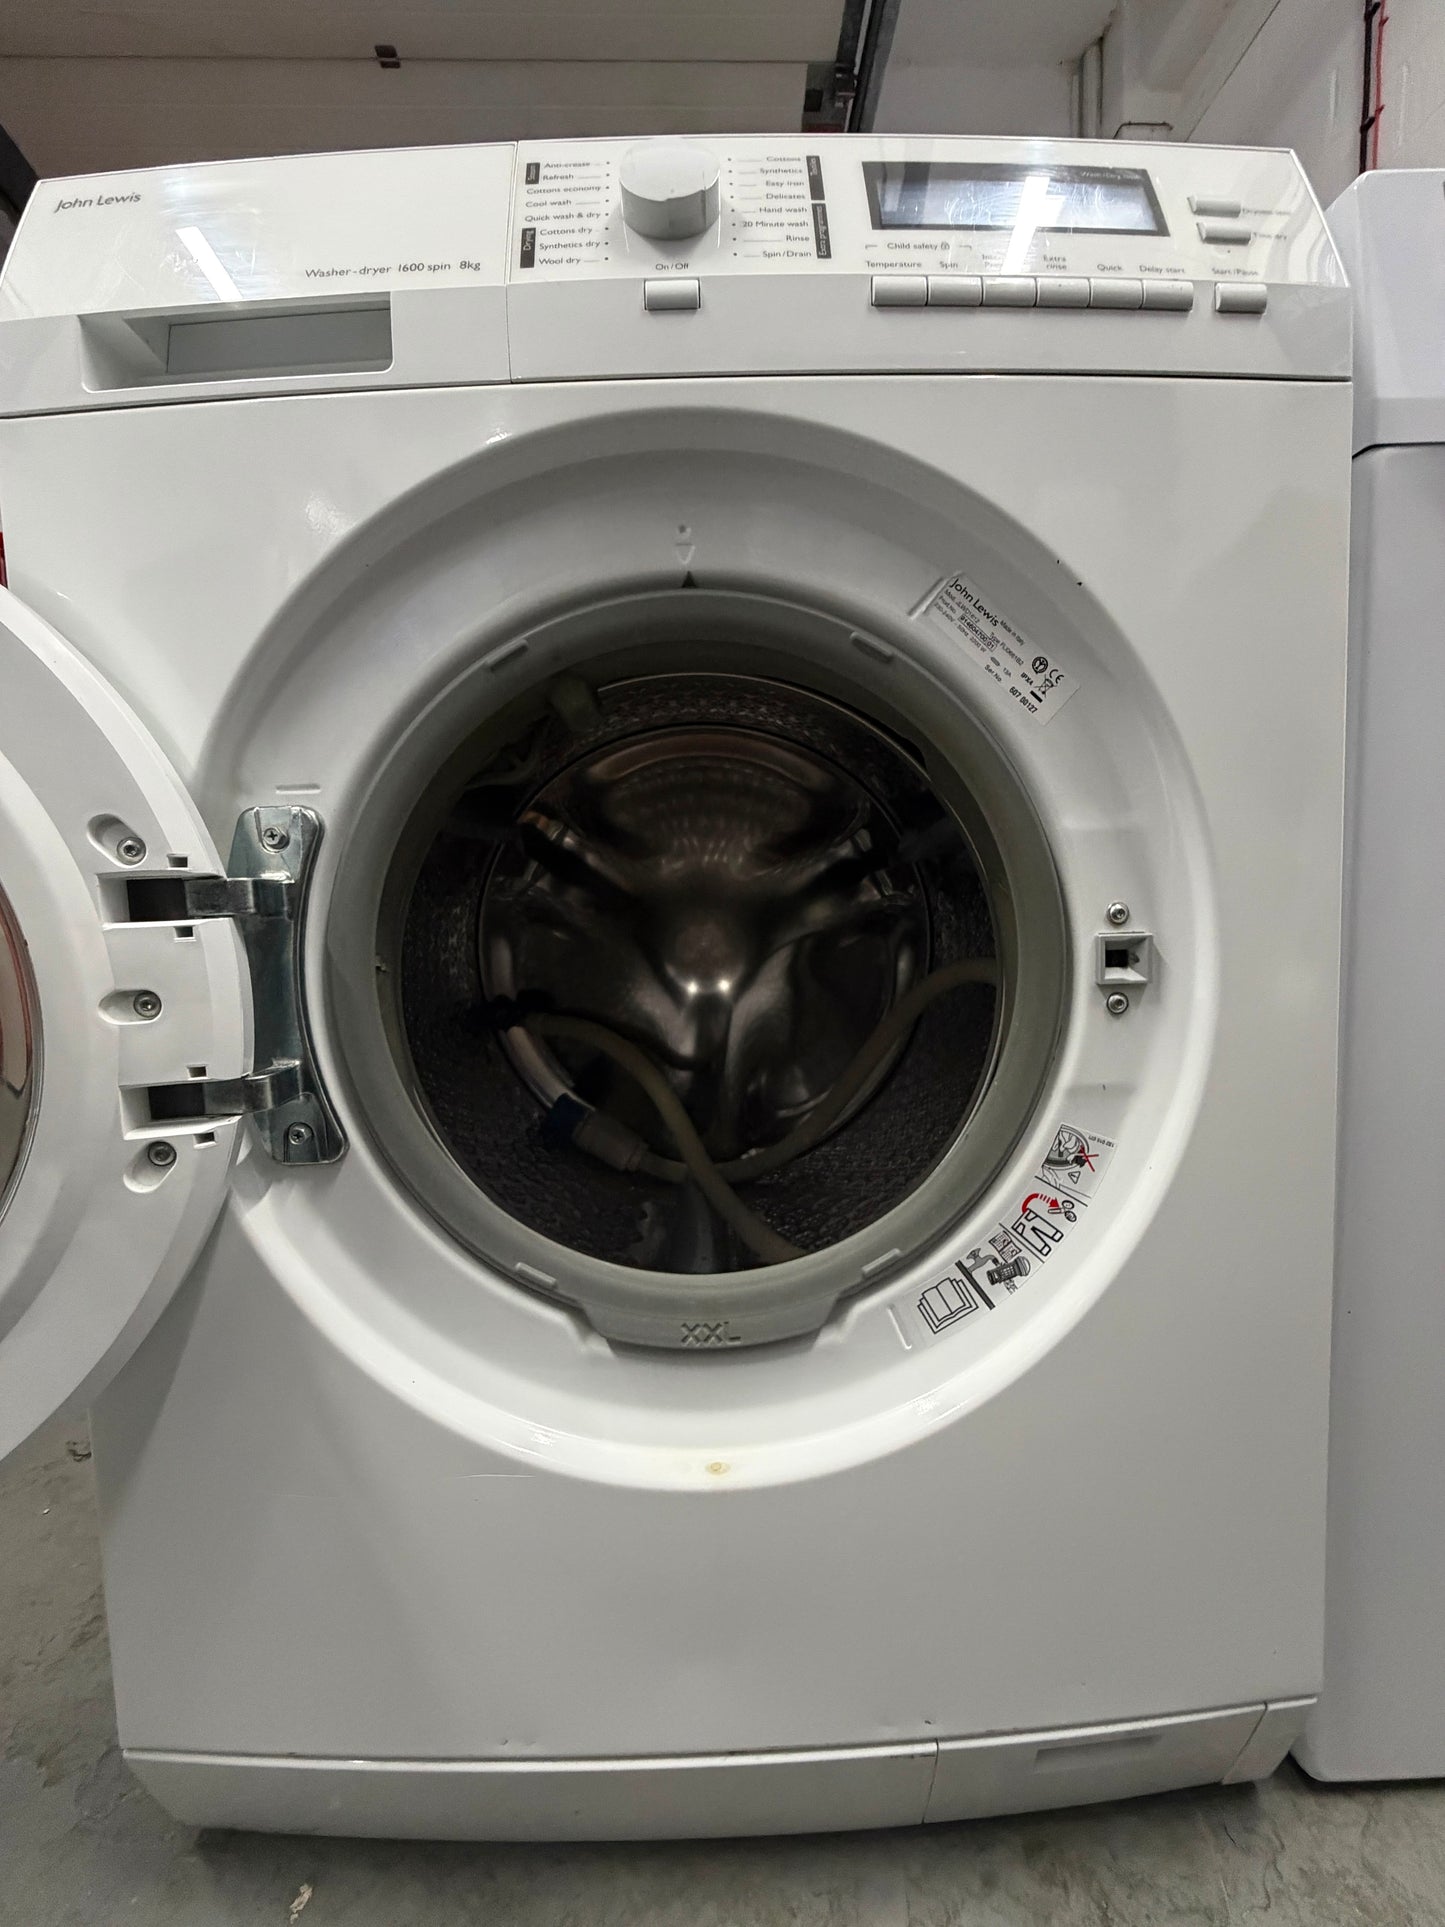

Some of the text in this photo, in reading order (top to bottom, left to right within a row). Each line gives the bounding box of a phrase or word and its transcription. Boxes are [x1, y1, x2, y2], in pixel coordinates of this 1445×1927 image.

[526, 185, 601, 195] Cottons economy
[765, 192, 806, 200] Delicates
[54, 192, 142, 213] John Lewis
[524, 214, 550, 222] Quick
[586, 212, 601, 220] dry
[755, 220, 785, 228] Minute
[578, 227, 592, 235] dry
[785, 234, 810, 242] Rinse
[539, 240, 601, 251] Synthetics dry
[886, 242, 938, 251] Child safety
[538, 257, 581, 266] Wool dry
[866, 260, 922, 269] Temperature
[939, 260, 959, 269] Spin
[304, 260, 481, 279] Washer-dryer 1600 spin 8kg
[1096, 263, 1123, 272] Quick
[1139, 264, 1163, 274] Delay
[949, 578, 1000, 627] John Lewis
[681, 1321, 742, 1345] XXL
